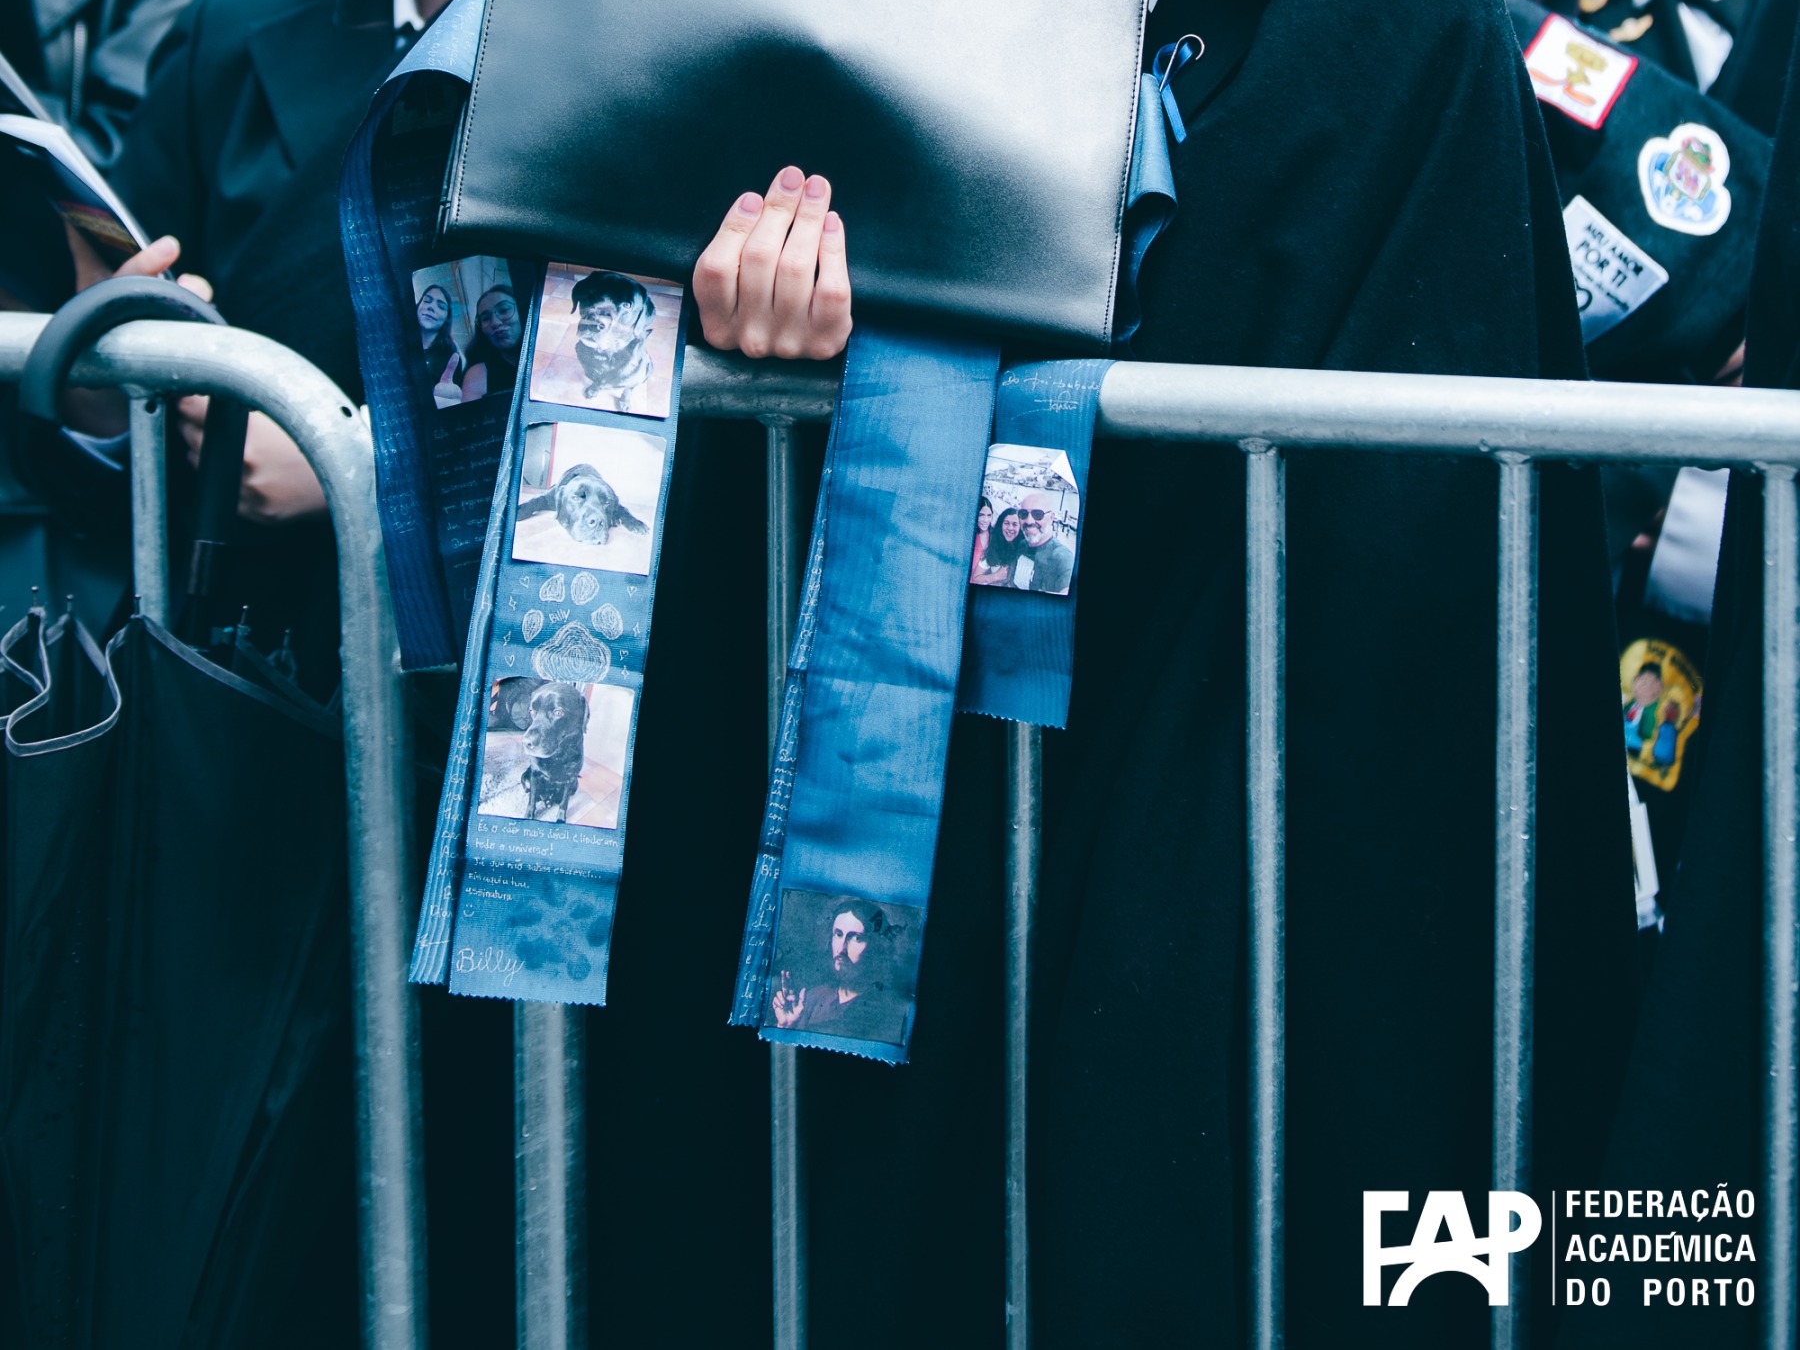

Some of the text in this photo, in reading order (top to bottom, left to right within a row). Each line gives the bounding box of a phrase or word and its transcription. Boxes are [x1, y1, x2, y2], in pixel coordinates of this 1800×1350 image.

[1575, 239, 1611, 275] POR
[1611, 267, 1629, 289] TI
[475, 837, 496, 850] todo
[499, 843, 507, 852] o
[456, 946, 526, 987] Billy
